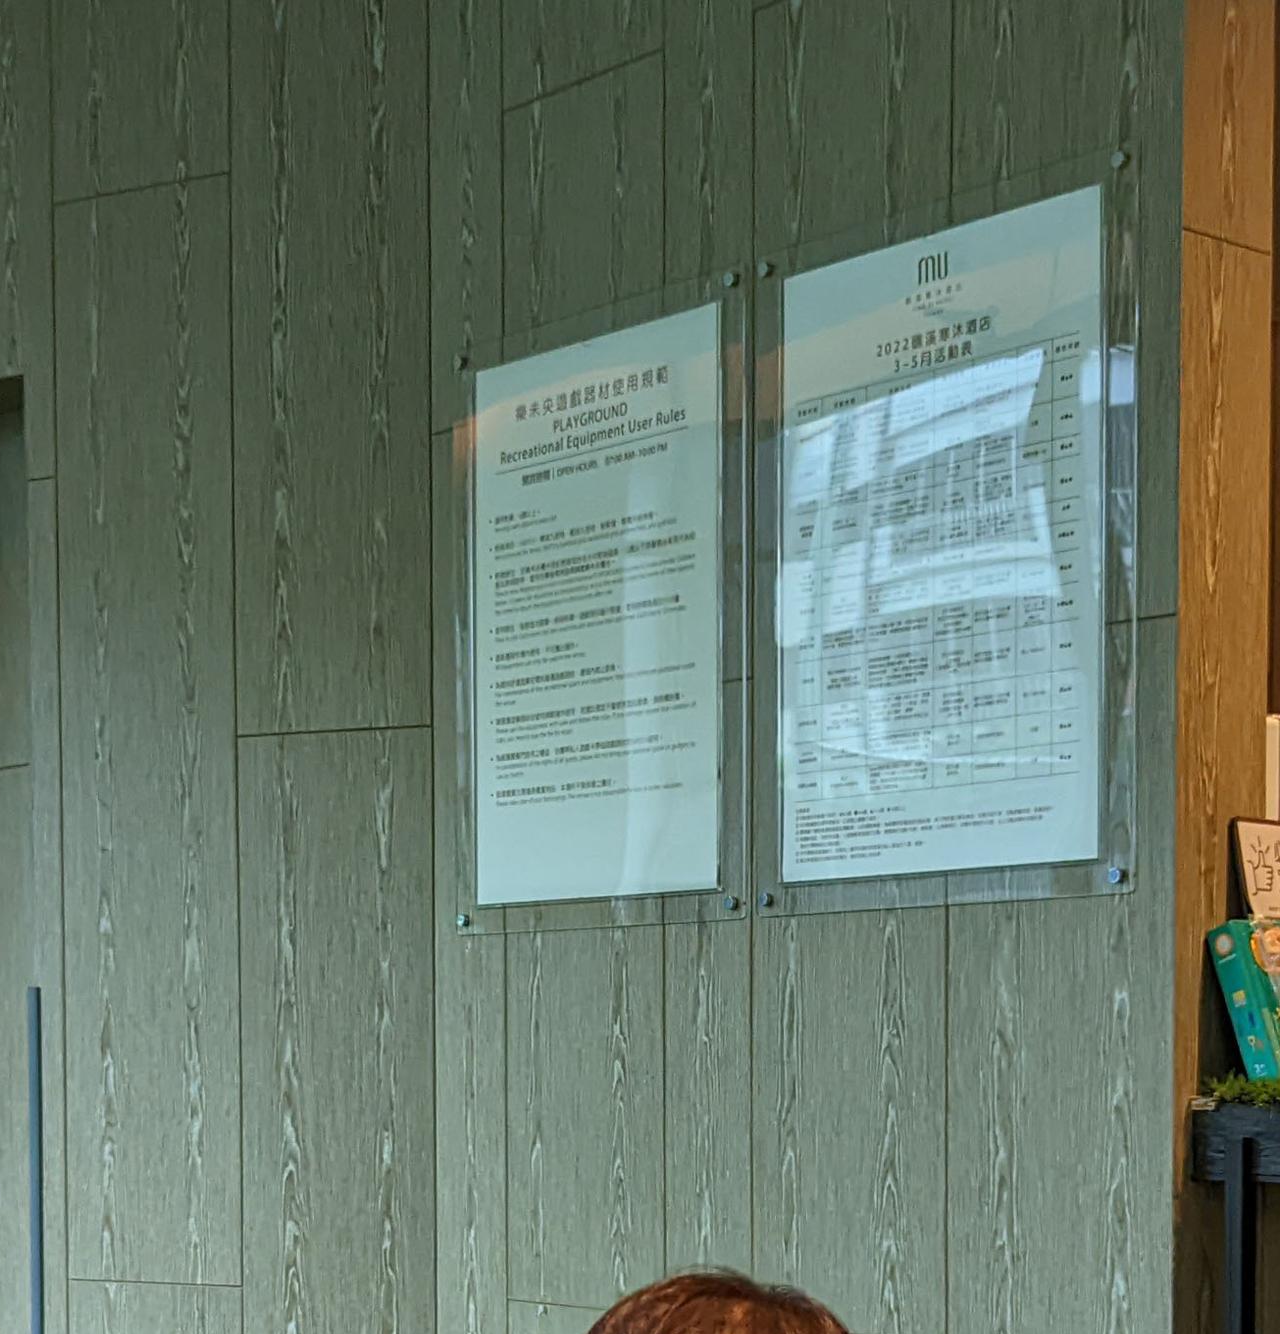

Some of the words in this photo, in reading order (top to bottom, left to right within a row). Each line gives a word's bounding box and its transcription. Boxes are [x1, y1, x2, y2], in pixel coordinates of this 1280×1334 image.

[500, 437, 564, 465] Recreational
[566, 425, 625, 450] Equipment
[628, 418, 653, 434] User
[655, 408, 687, 425] Rules
[553, 402, 628, 433] PLAYGROUND
